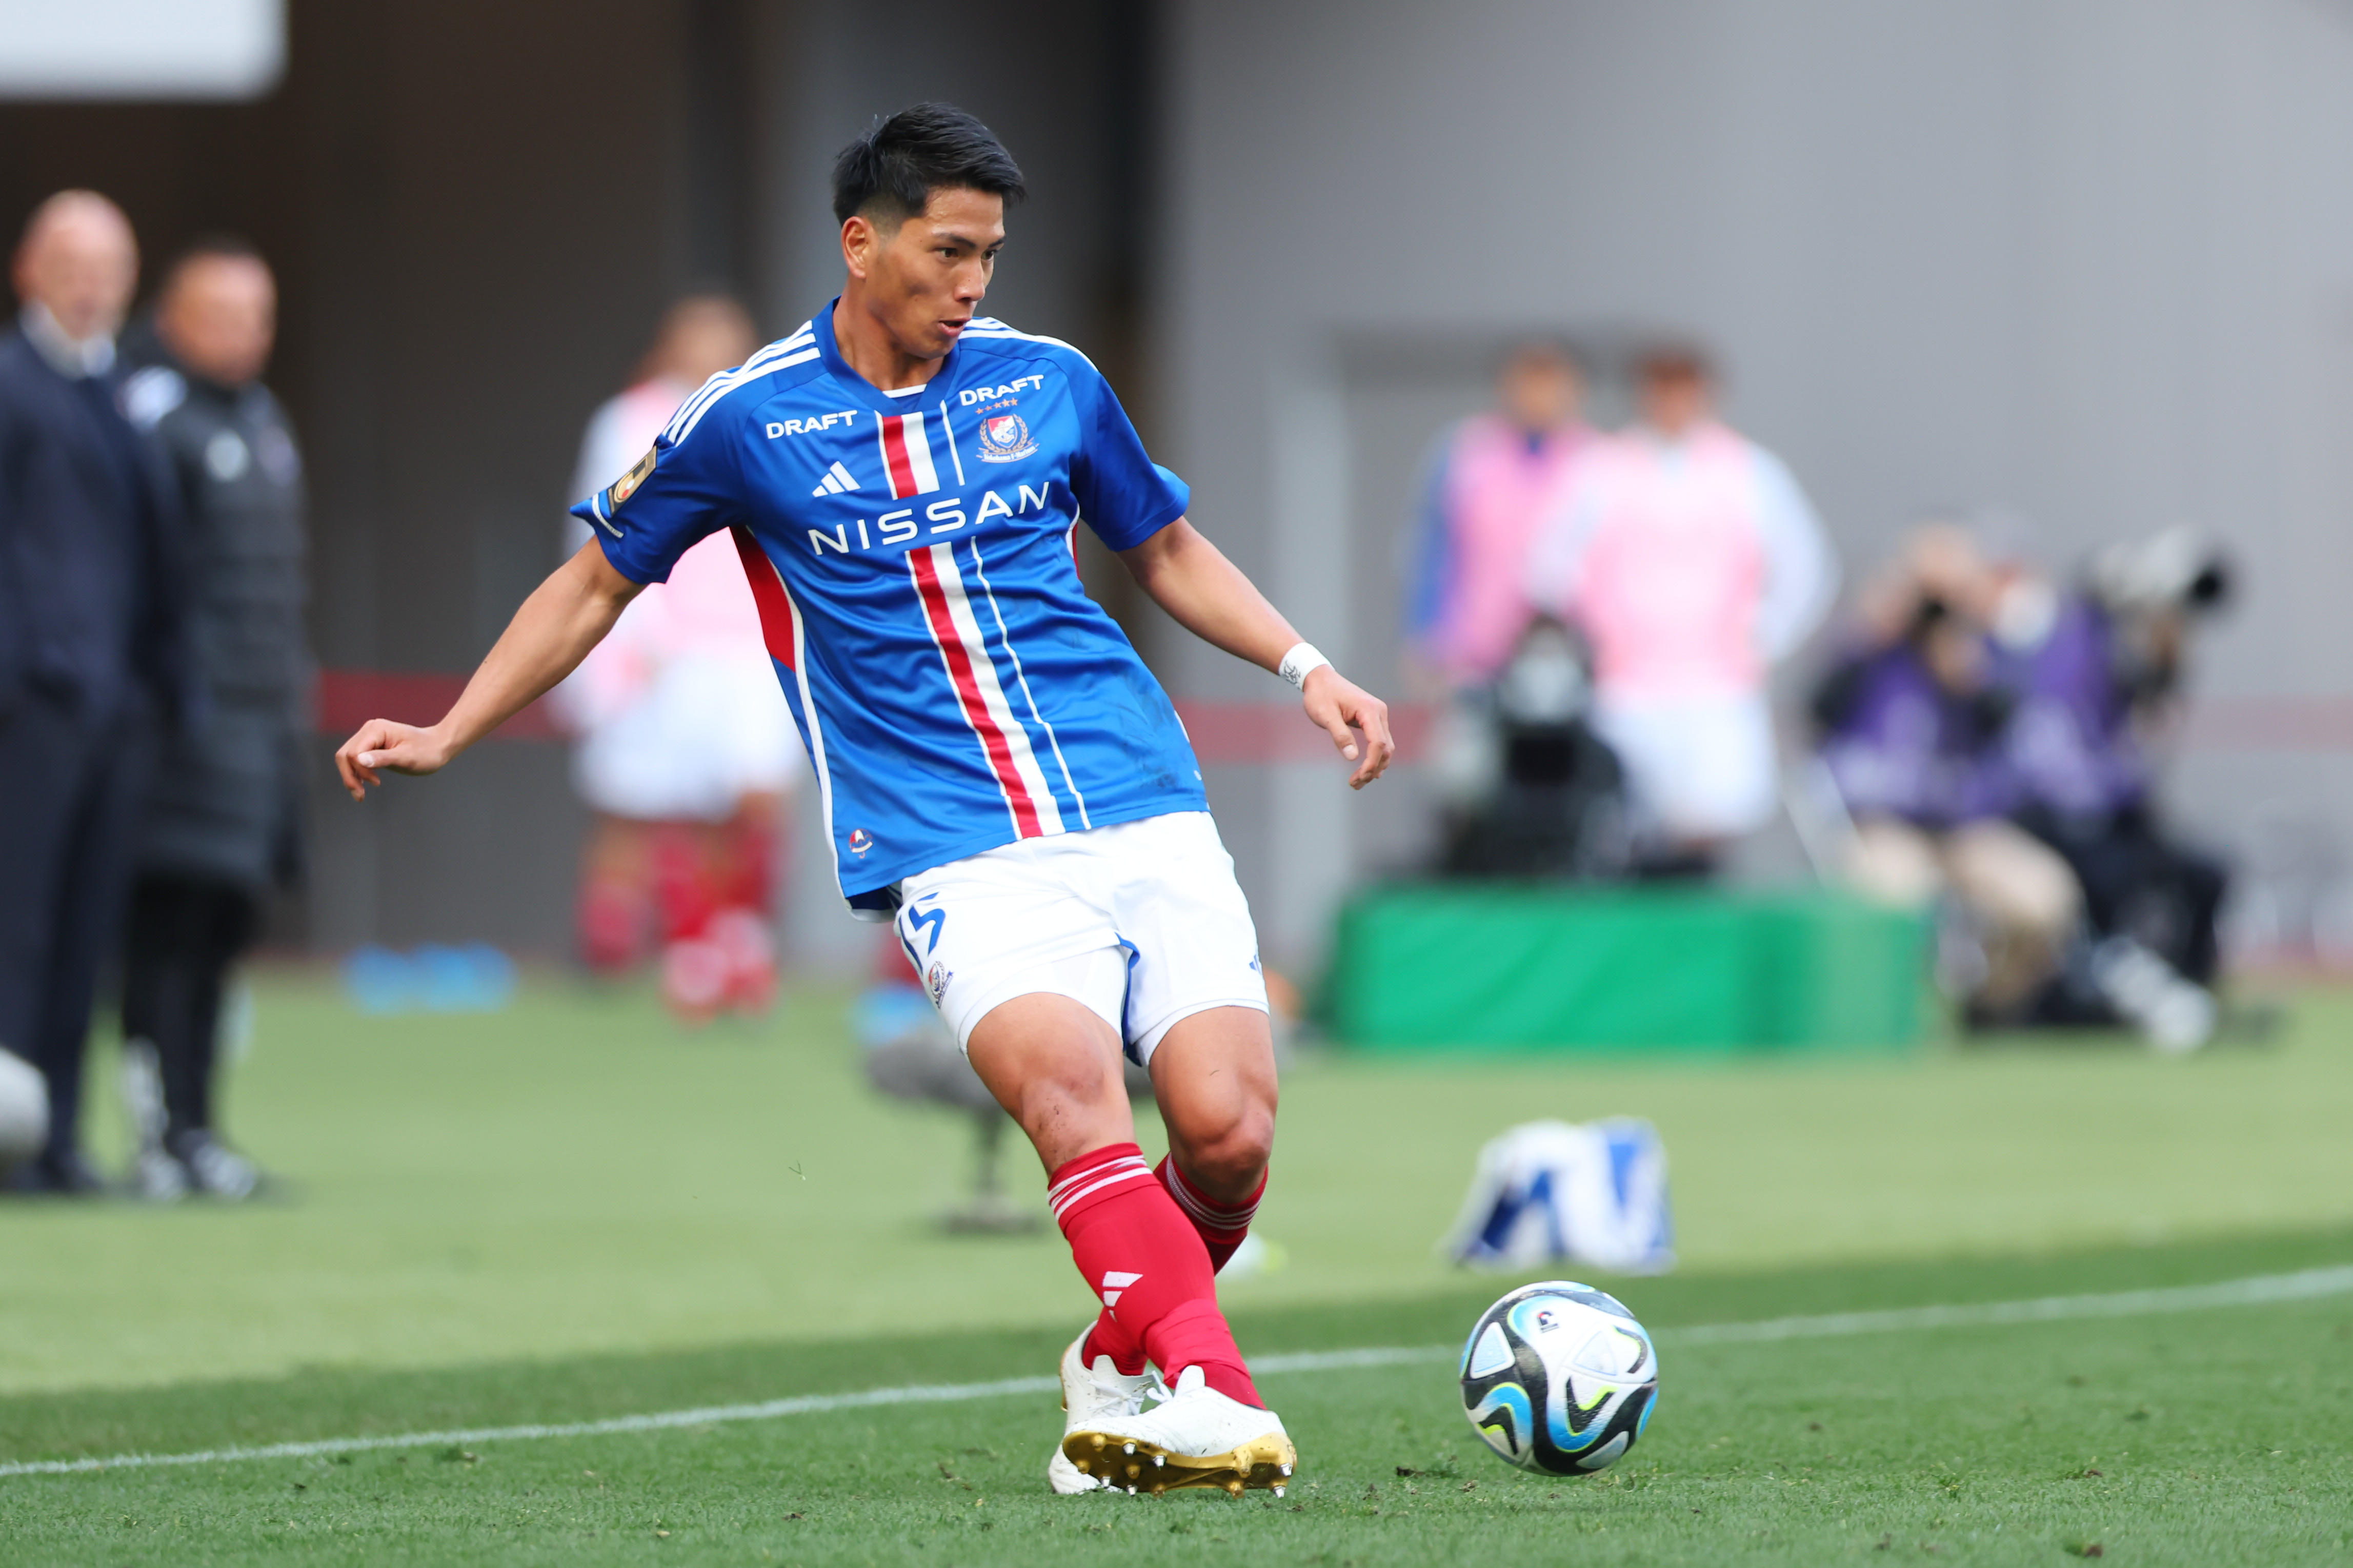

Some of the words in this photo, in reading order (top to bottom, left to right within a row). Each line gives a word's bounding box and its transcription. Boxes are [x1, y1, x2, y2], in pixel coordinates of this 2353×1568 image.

[959, 375, 1044, 406] DRAFT
[766, 410, 858, 439] DRAFT
[808, 481, 1049, 555] NISSAN
